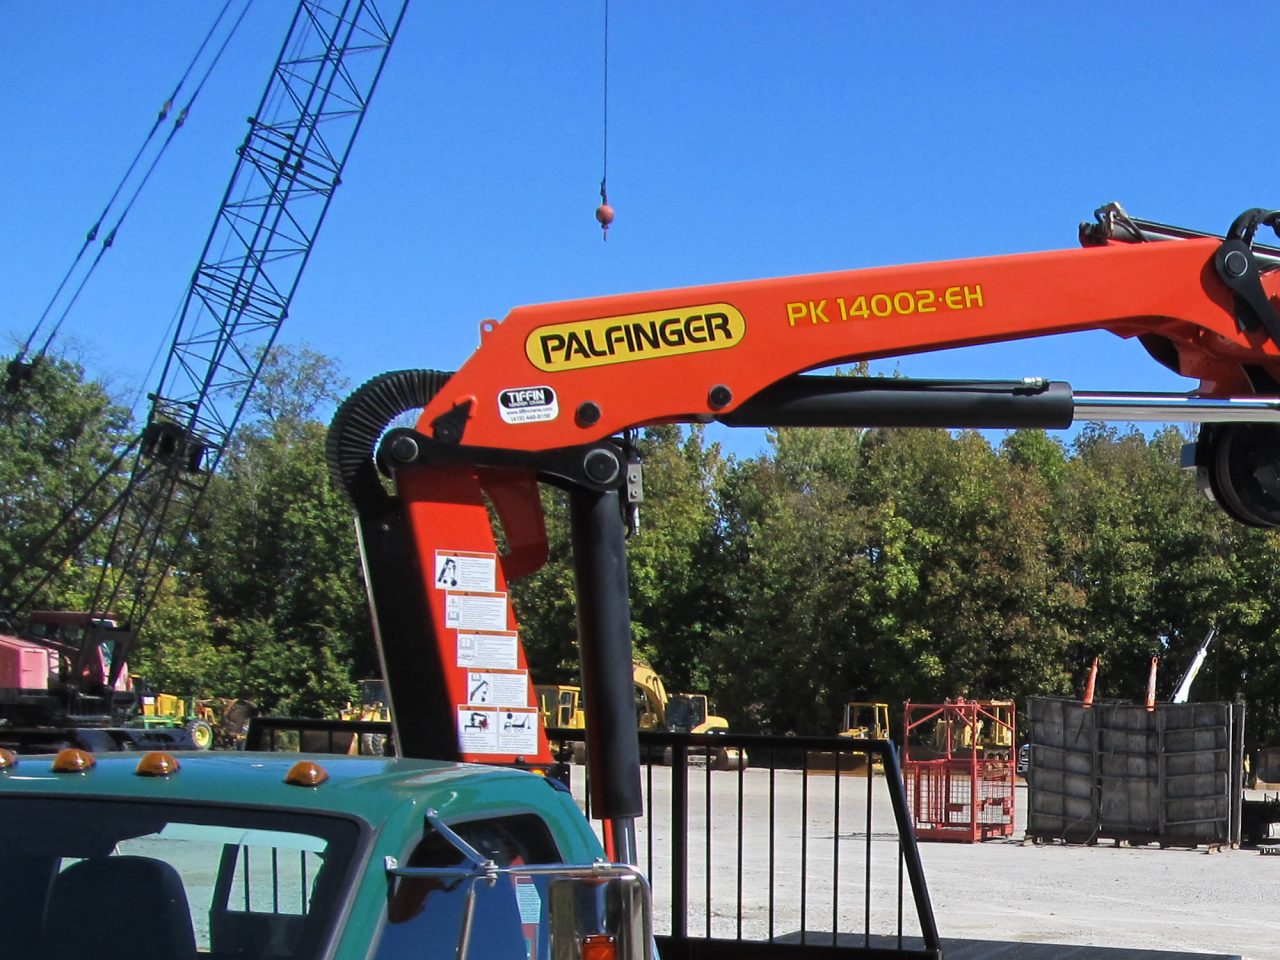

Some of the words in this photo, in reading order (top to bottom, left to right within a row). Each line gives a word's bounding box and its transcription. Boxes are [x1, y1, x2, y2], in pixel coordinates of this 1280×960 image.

[786, 299, 831, 327] PK
[539, 311, 734, 365] PALFINGER
[507, 390, 545, 403] TIFFIN
